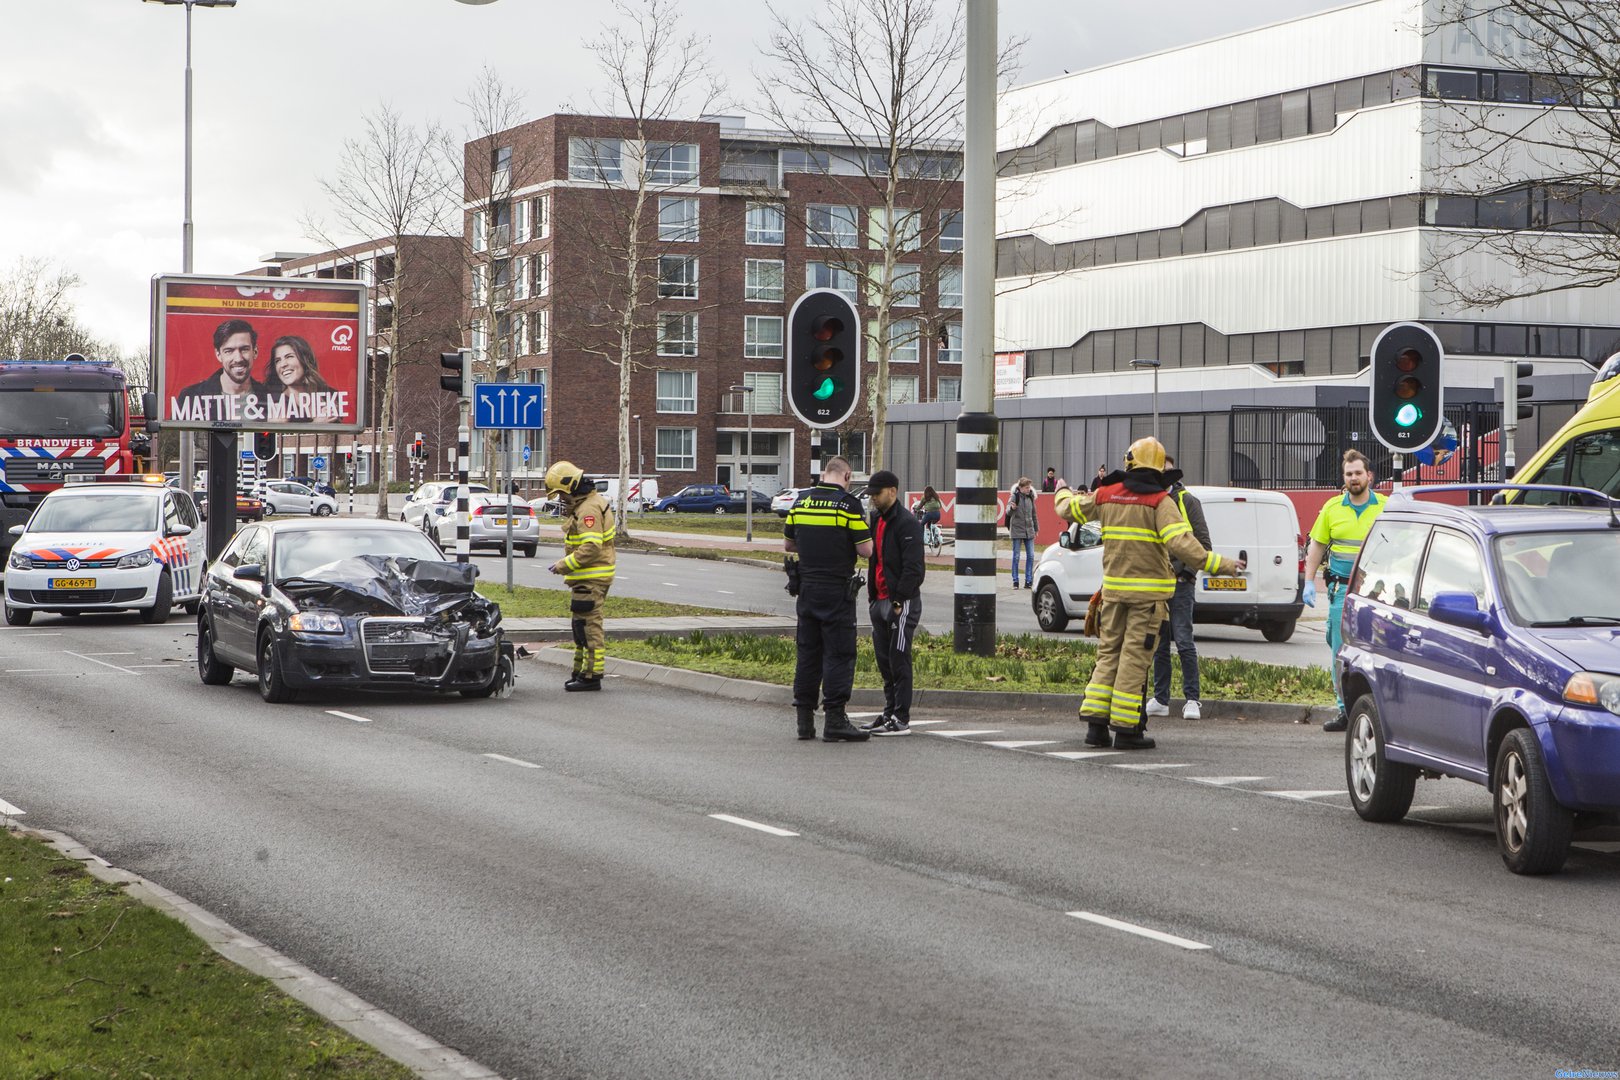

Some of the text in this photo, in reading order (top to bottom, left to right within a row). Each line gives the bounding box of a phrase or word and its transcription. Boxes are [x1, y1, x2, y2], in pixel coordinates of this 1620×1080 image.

[171, 391, 349, 421] MATTIE & MARIEKE
[17, 439, 94, 447] BRANDWEER
[37, 462, 74, 470] MAN
[54, 579, 93, 588] GG-469-T
[1210, 580, 1244, 588] VD-801-V
